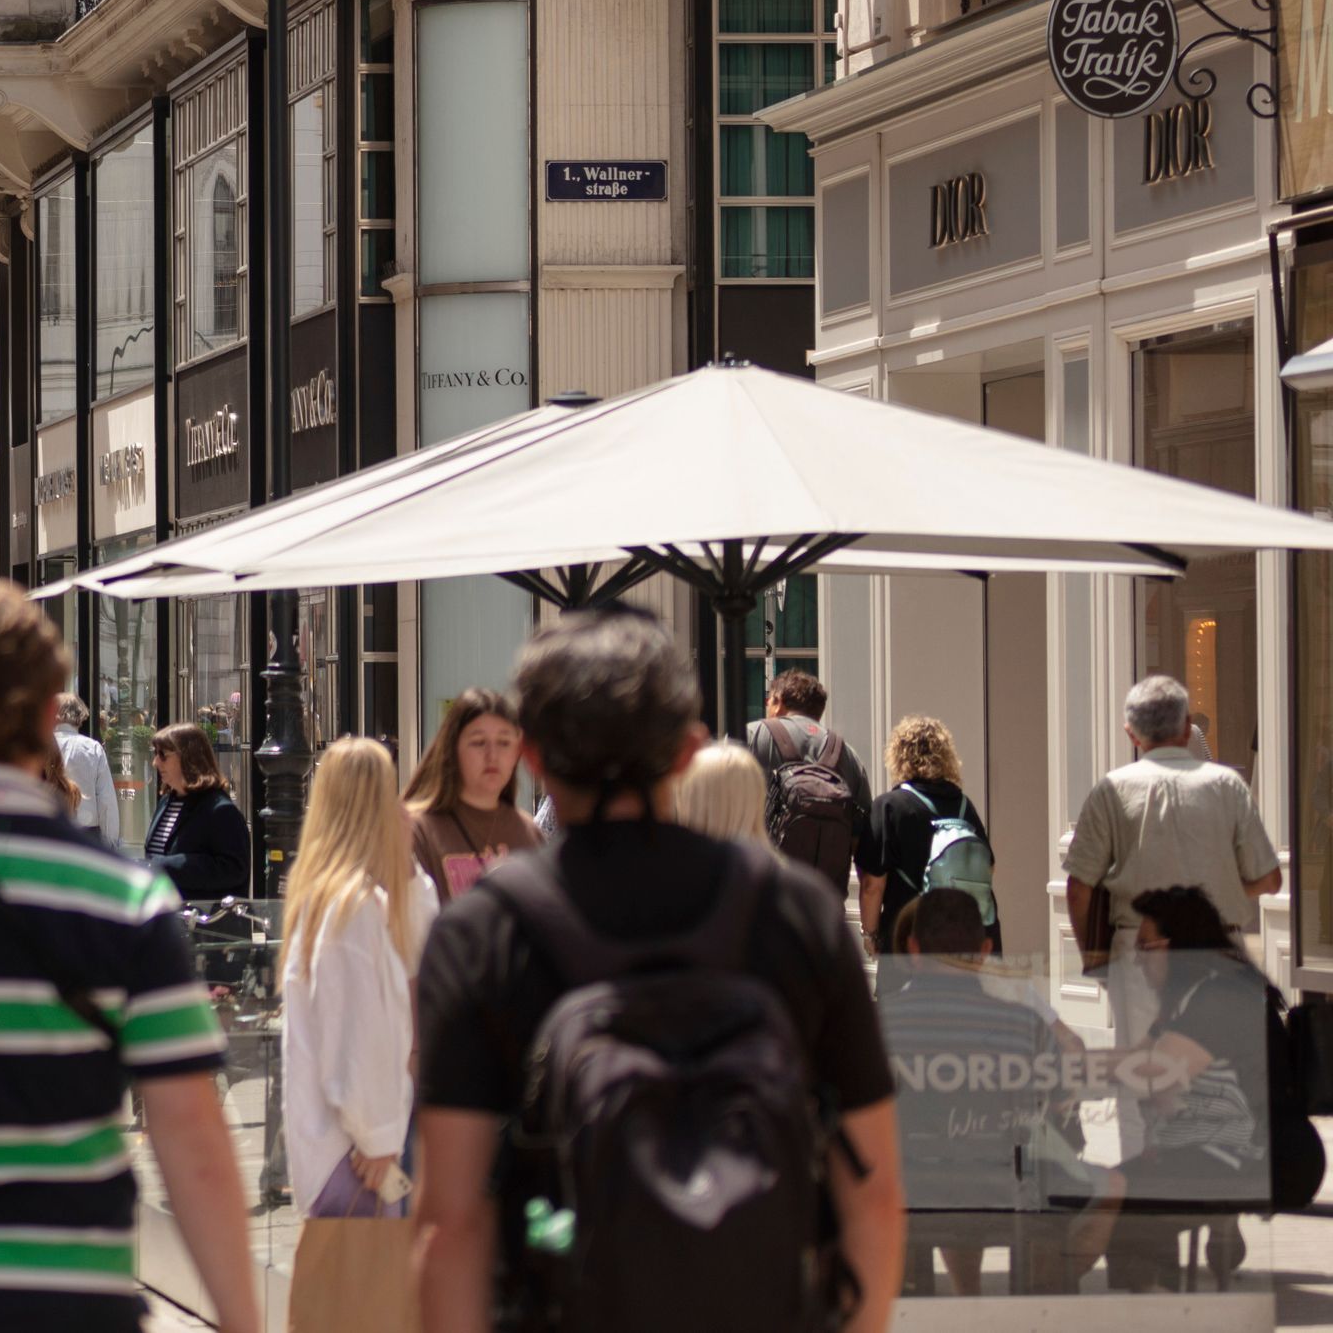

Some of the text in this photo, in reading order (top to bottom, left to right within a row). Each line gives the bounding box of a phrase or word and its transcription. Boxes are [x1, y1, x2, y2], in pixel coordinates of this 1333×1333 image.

[1062, 37, 1165, 78] Trafik
[1142, 98, 1215, 186] DIOR
[585, 182, 628, 197] straße
[929, 171, 989, 249] DIOR
[421, 370, 475, 389] TIFFANY
[477, 370, 490, 387] &
[890, 1051, 1109, 1093] NORDSEE
